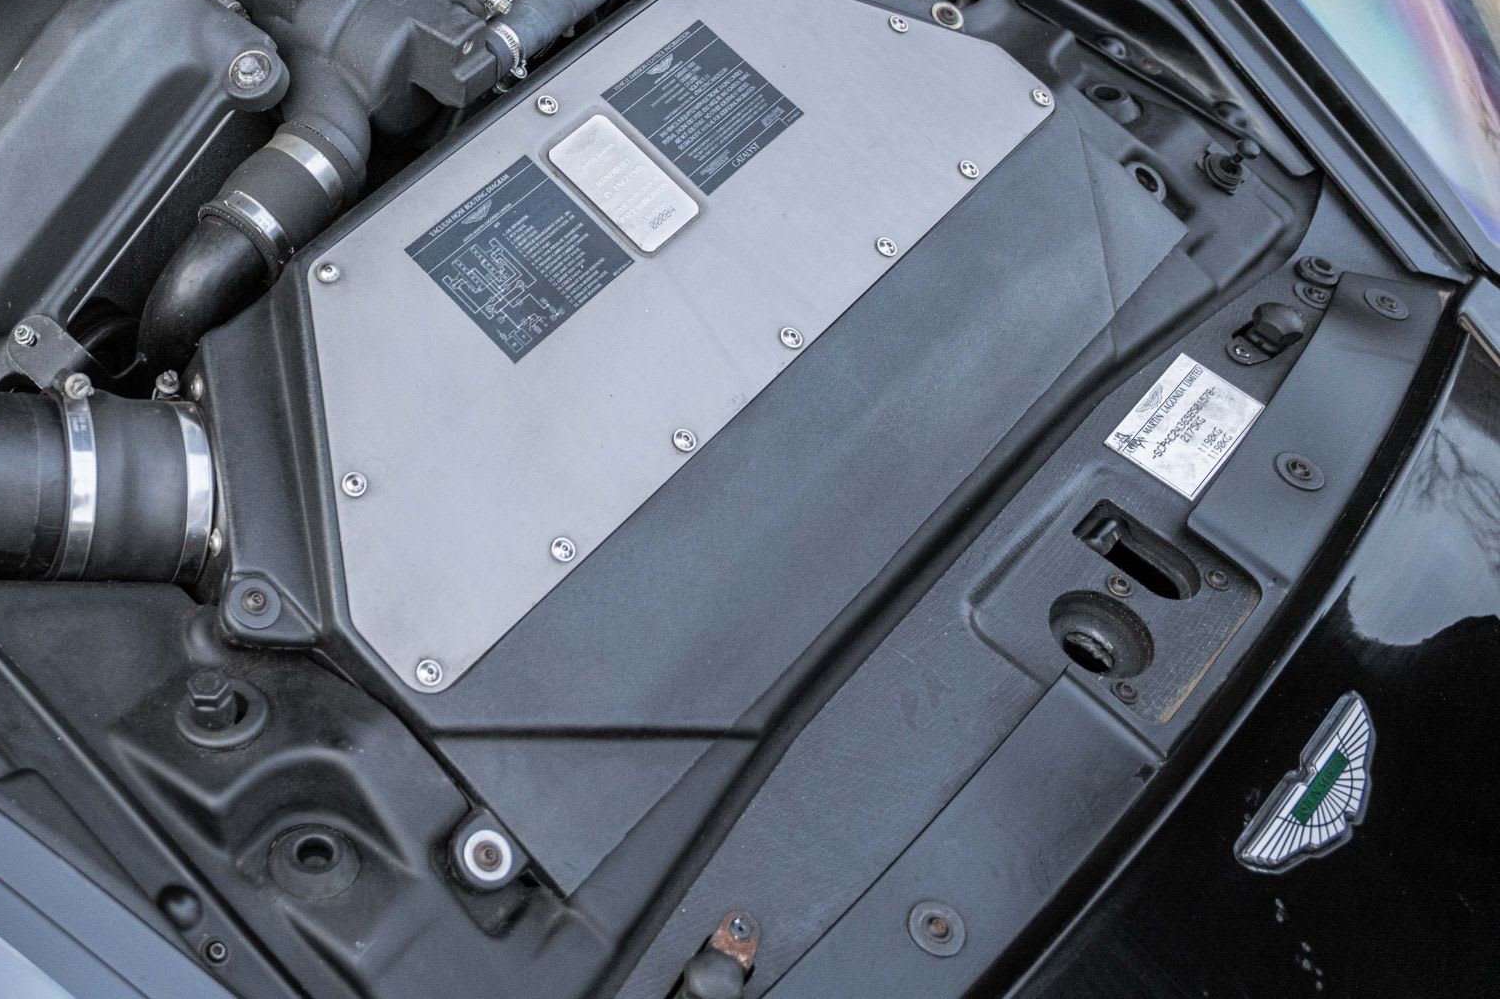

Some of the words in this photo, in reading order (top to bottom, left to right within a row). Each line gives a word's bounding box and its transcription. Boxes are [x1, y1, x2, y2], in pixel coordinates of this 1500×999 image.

[730, 141, 761, 168] CATALYST
[428, 217, 453, 237] VACUUM
[450, 207, 466, 220] HOSE
[463, 190, 487, 210] ROUTING
[484, 173, 509, 193] DIAGRAM
[646, 204, 678, 230] 00084
[1141, 412, 1164, 435] MARTIN
[1160, 385, 1186, 414] LAGONDA
[1182, 366, 1204, 387] LIMITED
[1179, 415, 1206, 443] 2175KG
